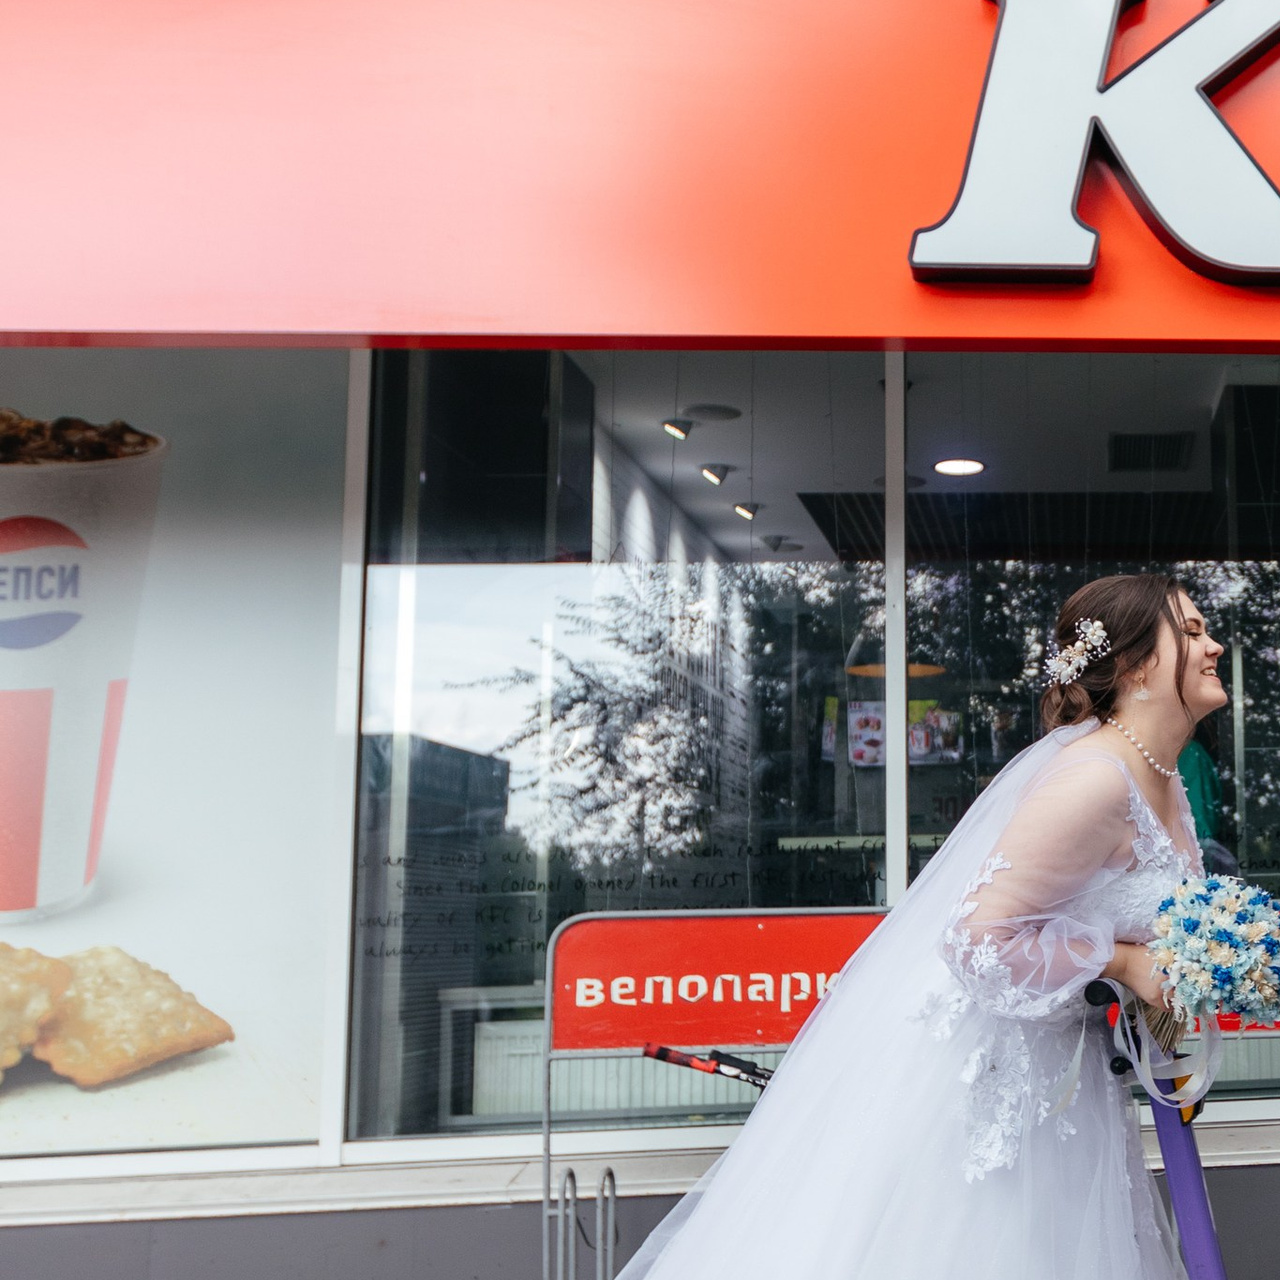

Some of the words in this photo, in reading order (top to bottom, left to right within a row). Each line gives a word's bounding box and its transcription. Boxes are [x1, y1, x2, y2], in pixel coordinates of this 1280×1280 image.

[501, 875, 562, 894] Colonel
[648, 872, 679, 889] the
[691, 871, 741, 889] first
[475, 905, 514, 925] KFC
[485, 937, 547, 961] gettin
